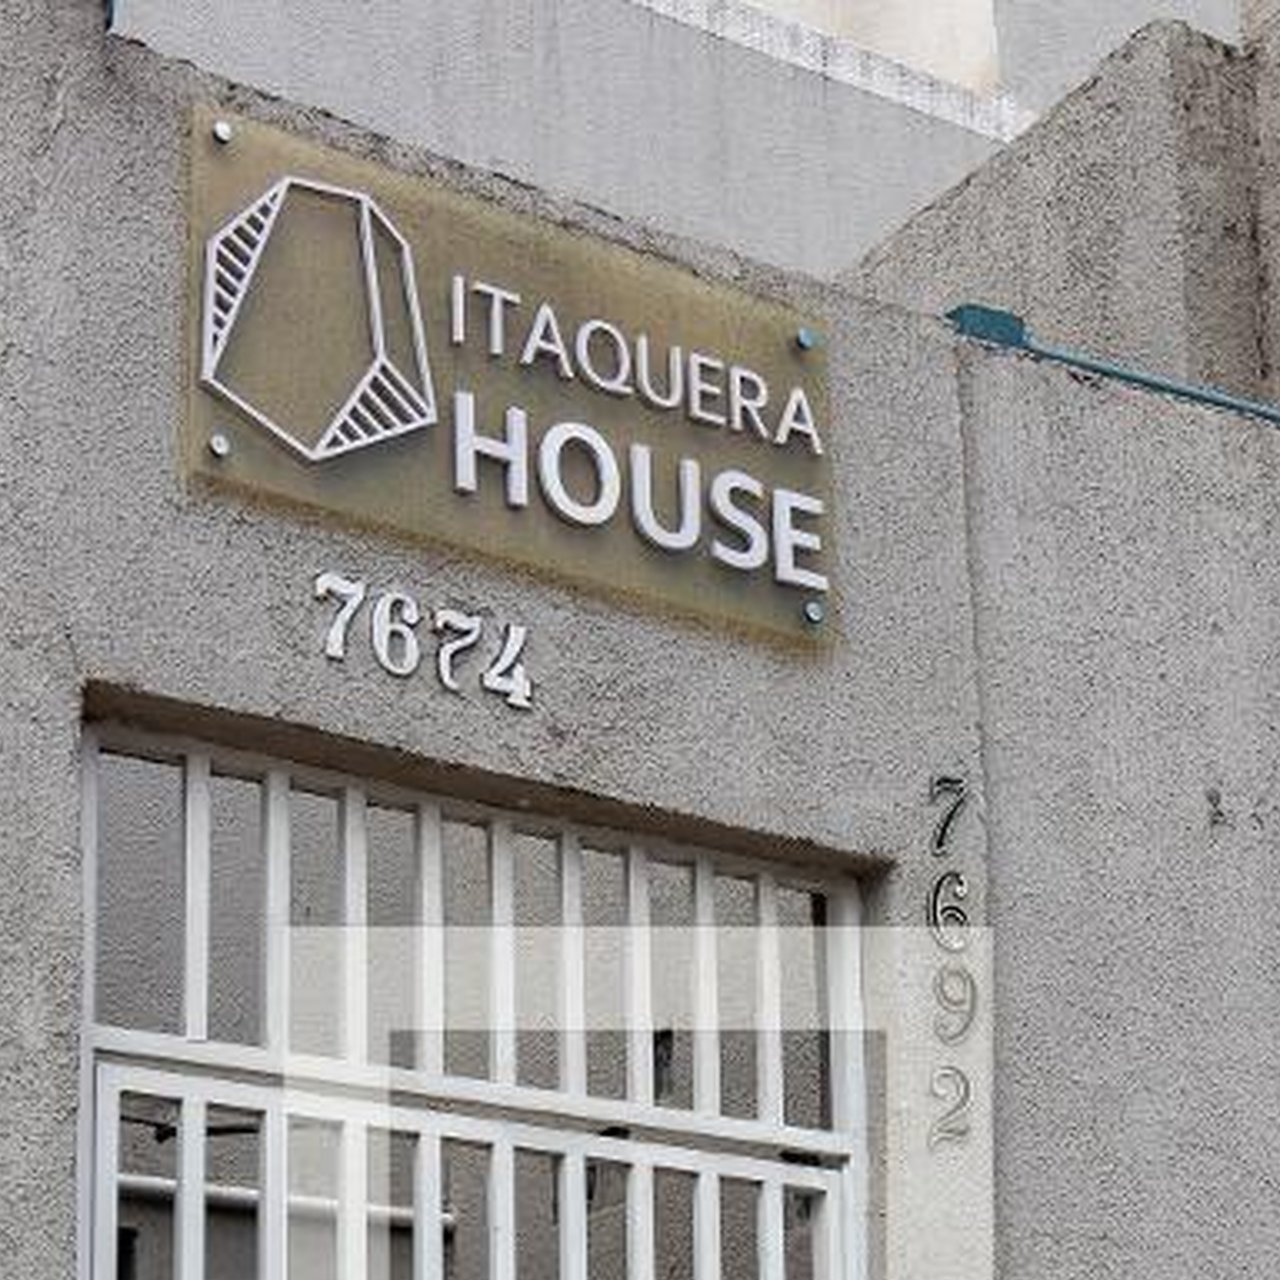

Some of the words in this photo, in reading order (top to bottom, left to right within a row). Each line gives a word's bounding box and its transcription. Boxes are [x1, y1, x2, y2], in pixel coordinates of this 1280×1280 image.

[452, 275, 823, 455] ITAQUERA
[454, 391, 828, 592] HOUSE
[316, 572, 533, 707] 7674
[928, 776, 977, 1151] 7692
